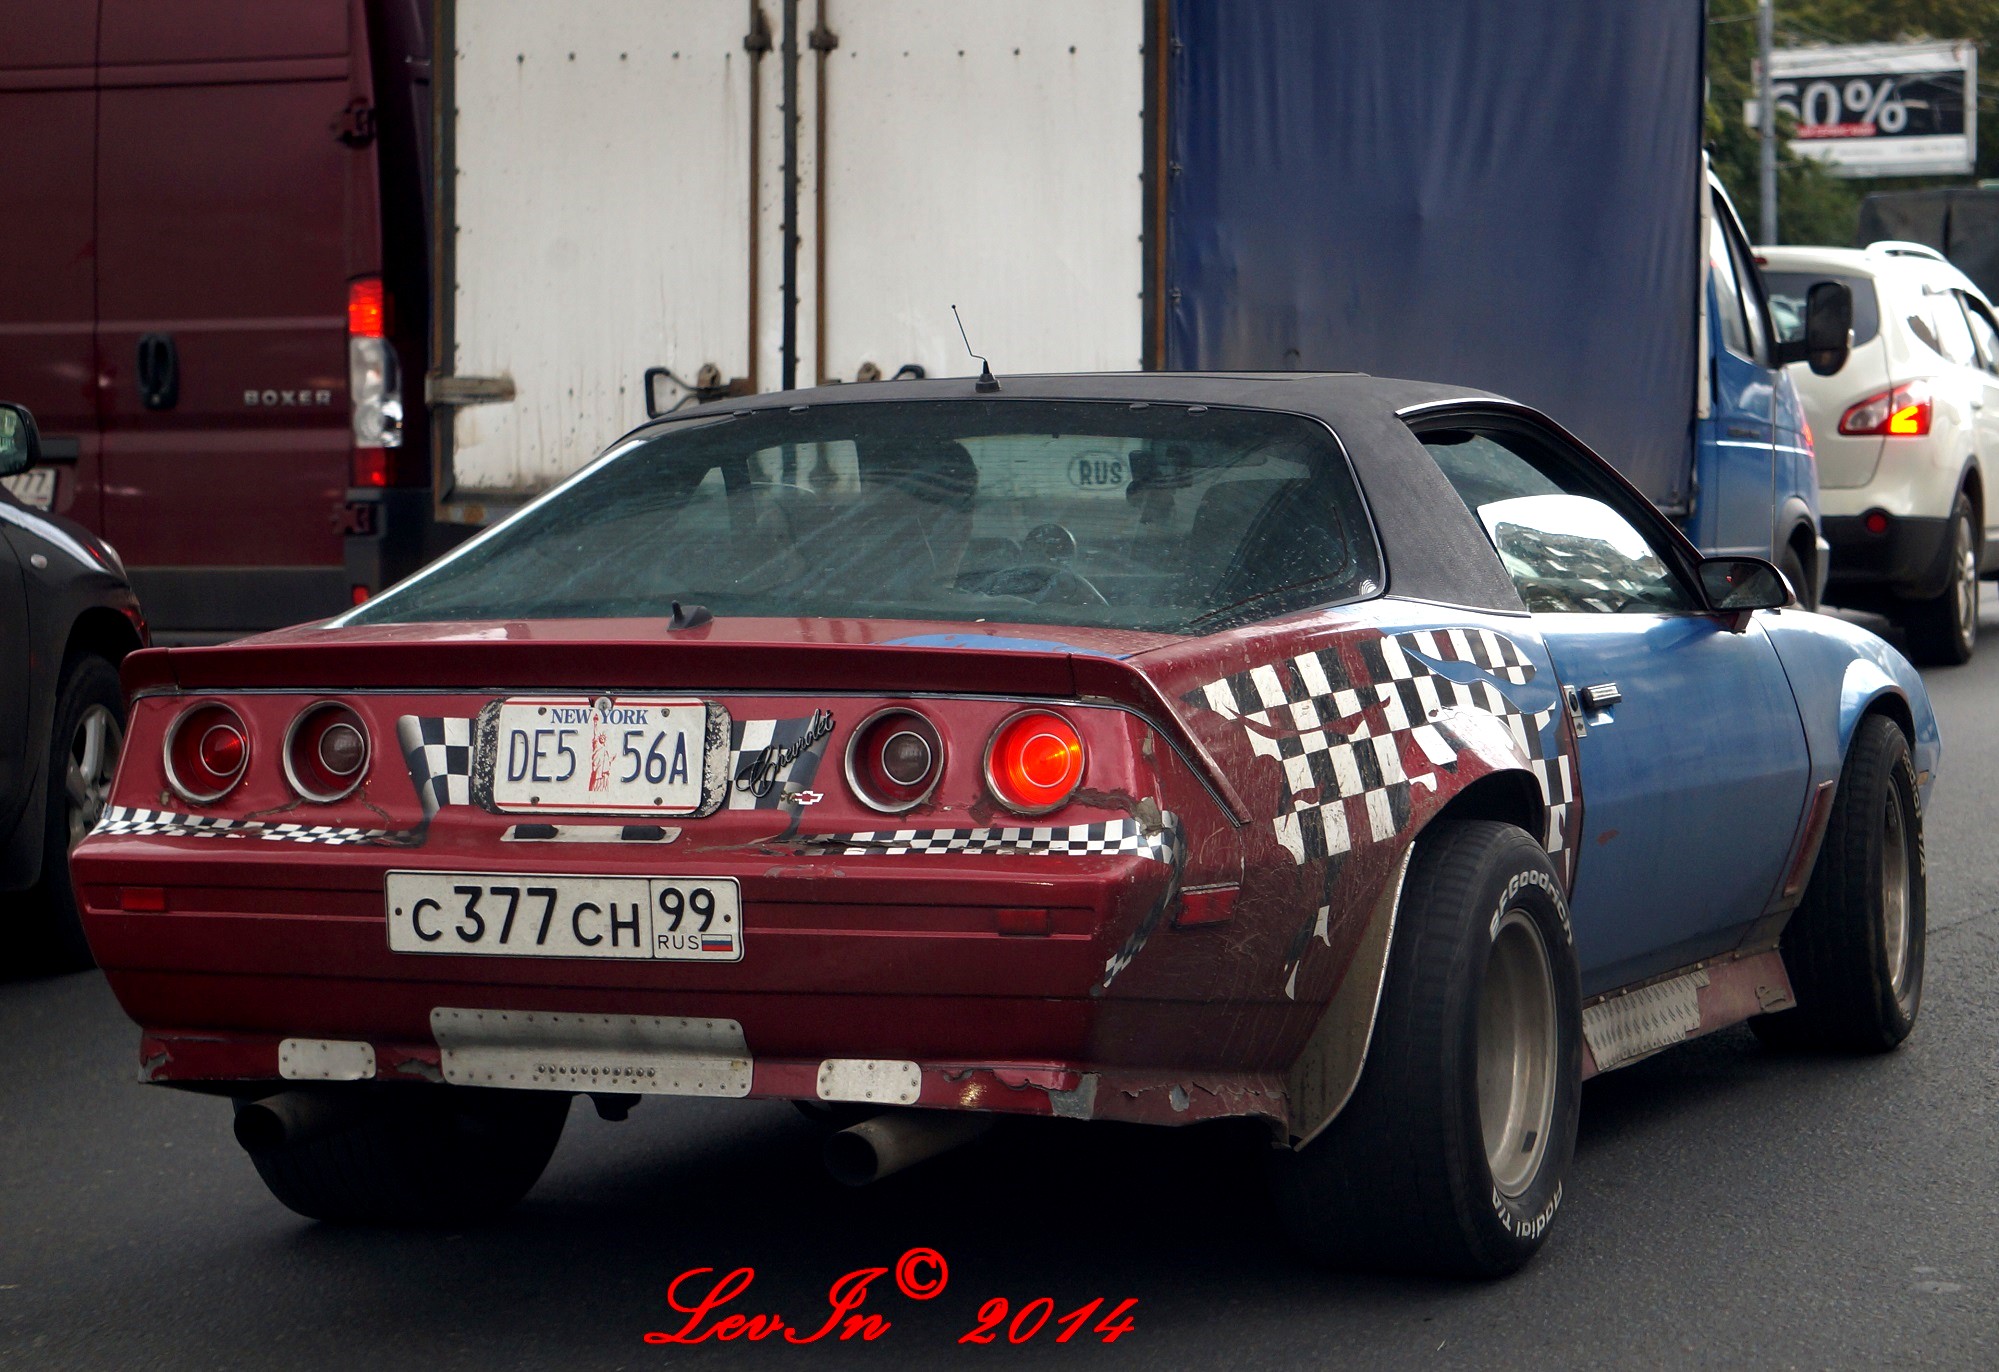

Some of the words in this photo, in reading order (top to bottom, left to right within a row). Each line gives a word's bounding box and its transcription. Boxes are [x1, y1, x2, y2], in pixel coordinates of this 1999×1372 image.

[244, 389, 331, 406] BOXER
[1079, 459, 1122, 485] RUS
[550, 708, 593, 725] NEW
[599, 709, 648, 725] YORK
[507, 729, 579, 782] DE5
[620, 730, 690, 784] 56A
[736, 708, 835, 798] Chevrolet
[659, 887, 716, 933] 99
[657, 934, 700, 950] RUS
